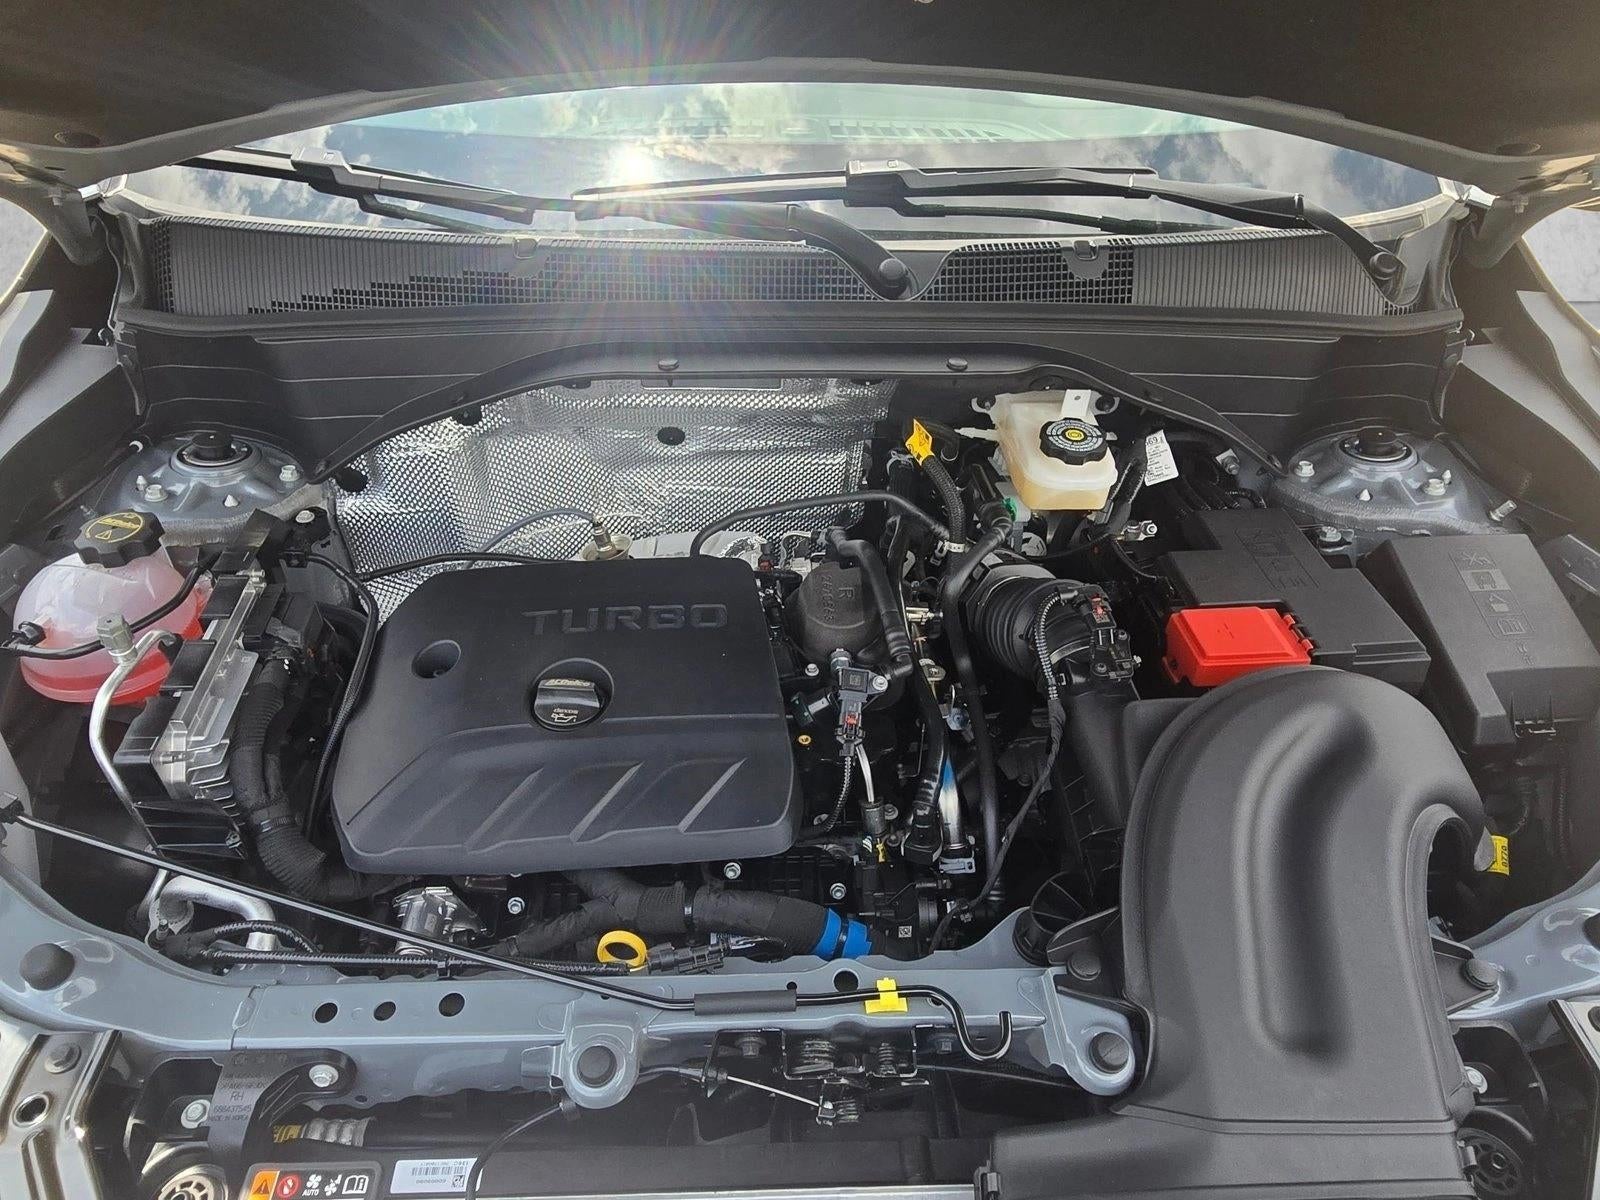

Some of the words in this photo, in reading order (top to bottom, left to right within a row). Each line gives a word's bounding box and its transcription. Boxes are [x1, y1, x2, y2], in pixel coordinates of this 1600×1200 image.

[521, 603, 728, 636] TURBO
[544, 678, 591, 687] ACDelco
[553, 707, 579, 715] dexos
[230, 1091, 245, 1101] RH
[302, 1189, 320, 1197] AUTO
